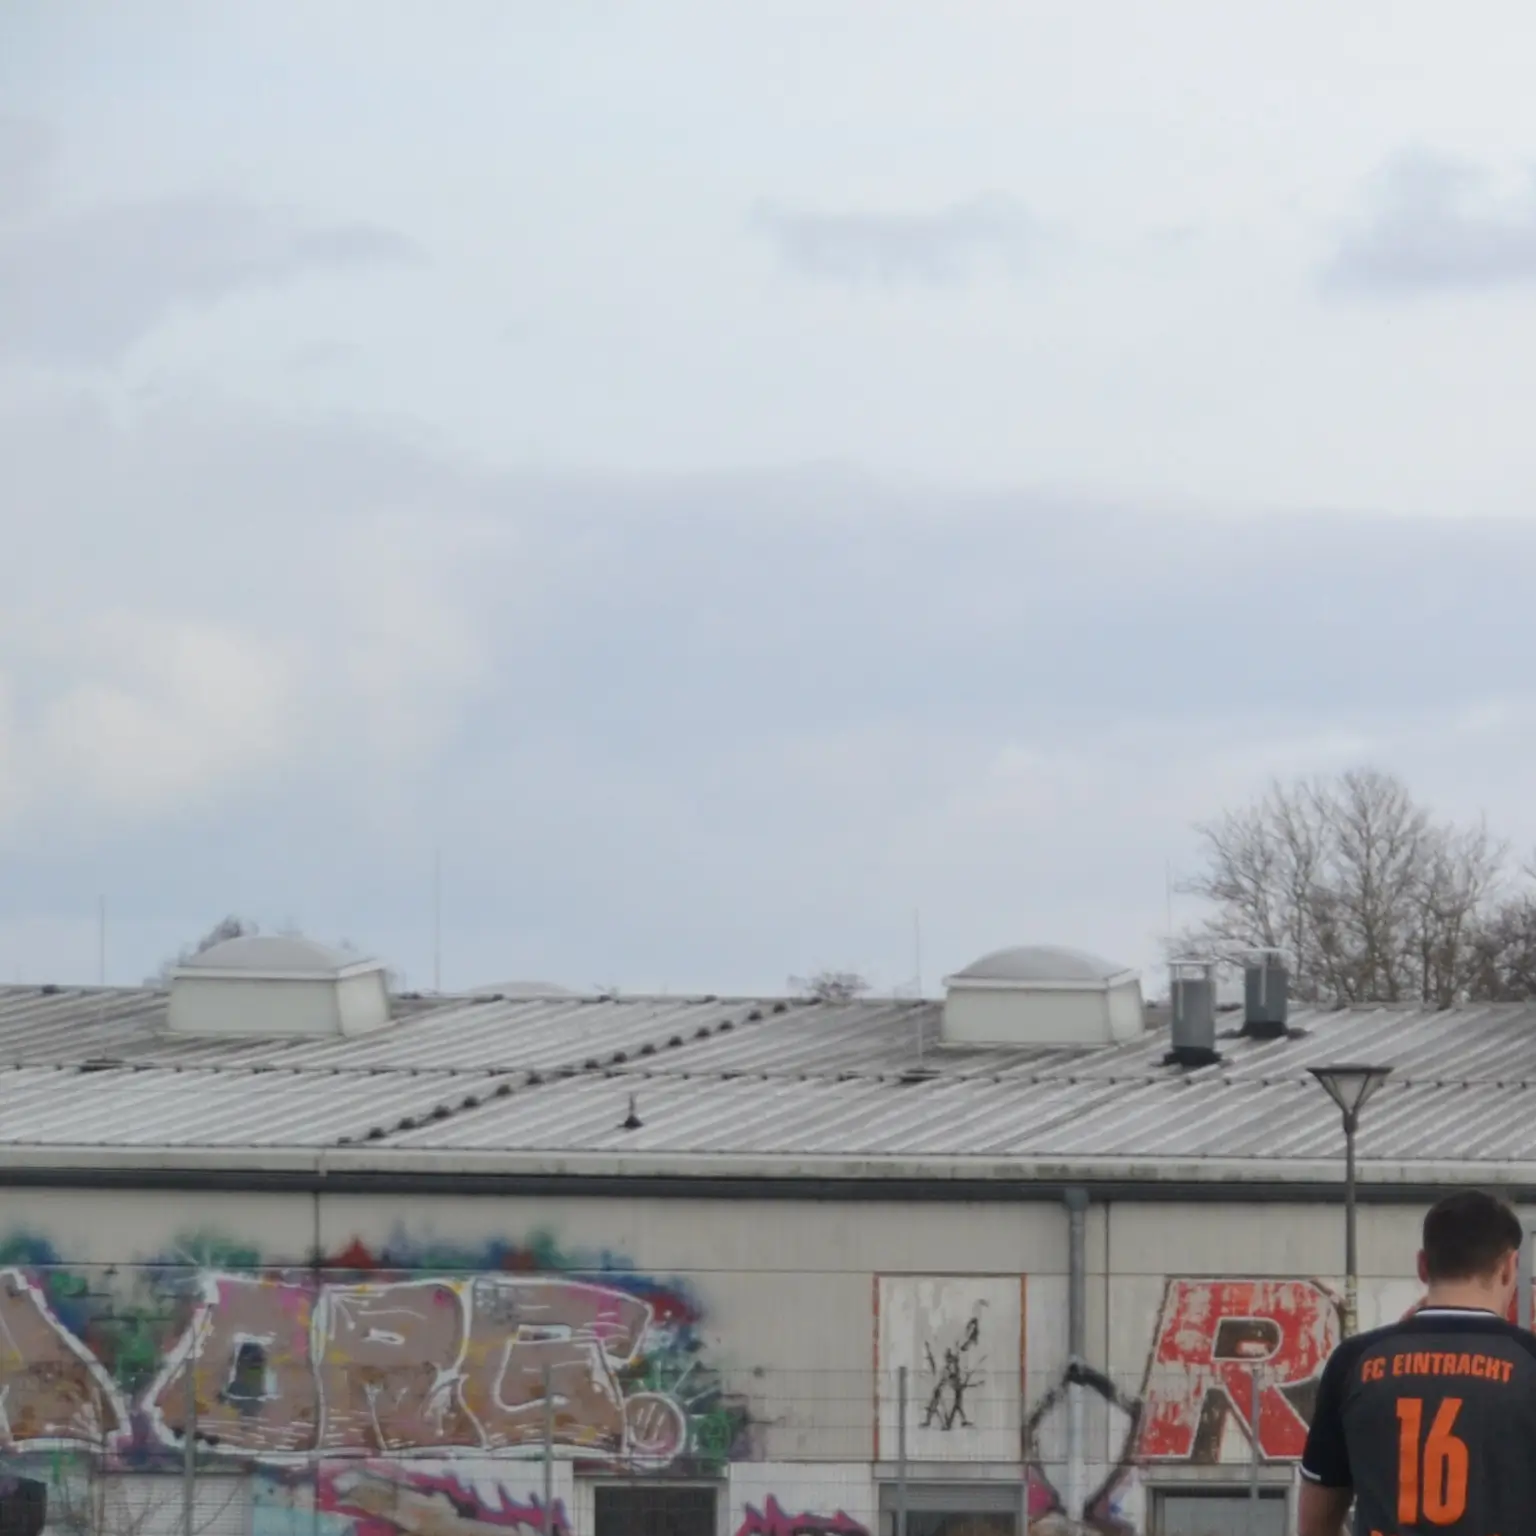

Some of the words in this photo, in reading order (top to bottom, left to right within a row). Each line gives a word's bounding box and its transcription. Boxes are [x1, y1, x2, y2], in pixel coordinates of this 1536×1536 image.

[1362, 1356, 1386, 1383] FC
[1392, 1351, 1514, 1383] EINTRACHT
[1396, 1397, 1469, 1526] 16
